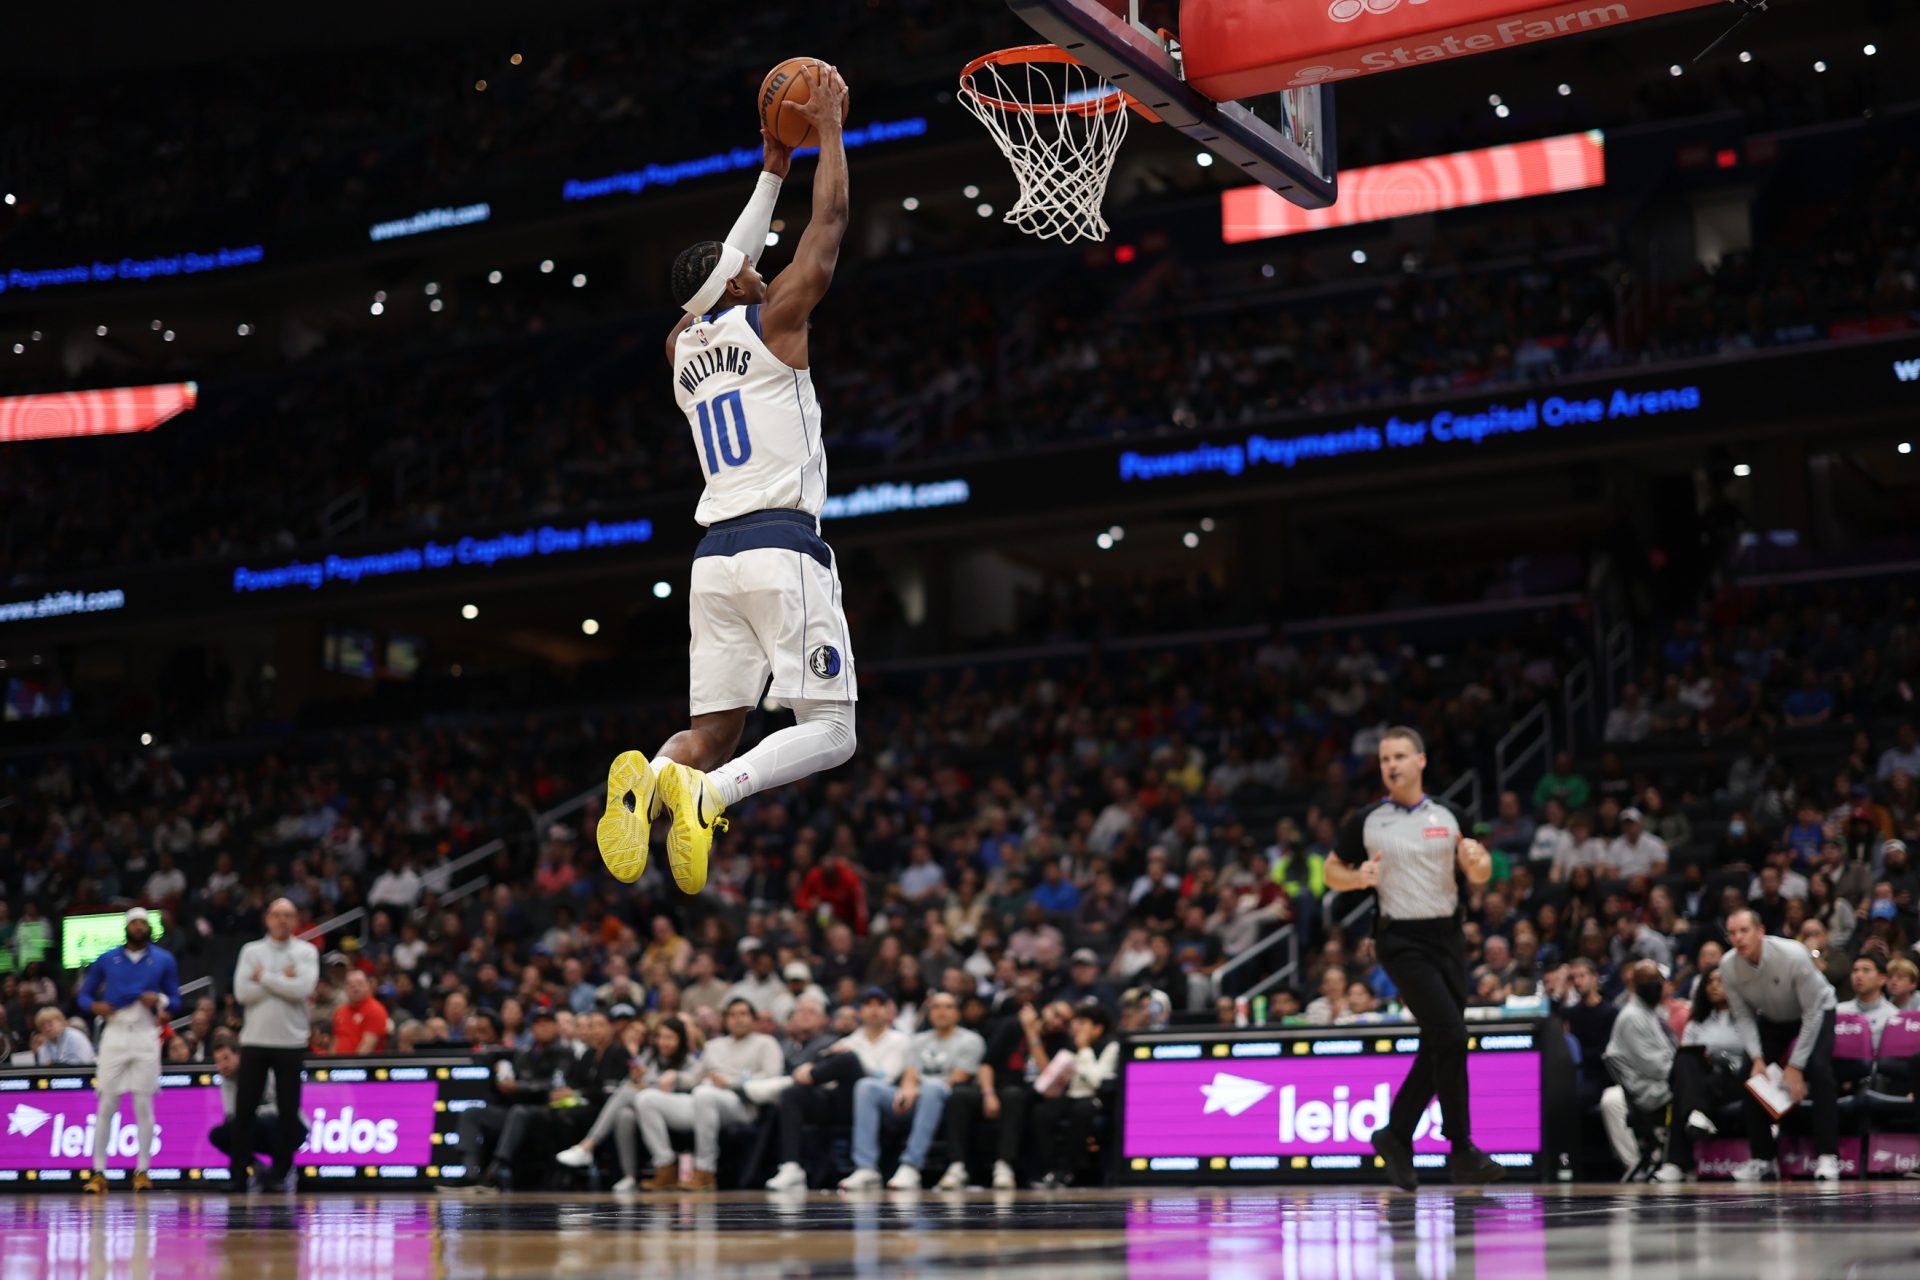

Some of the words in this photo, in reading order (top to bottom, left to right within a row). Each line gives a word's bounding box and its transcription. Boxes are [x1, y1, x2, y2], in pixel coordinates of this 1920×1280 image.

[679, 346, 752, 395] WILLIAMS
[696, 389, 752, 475] 10
[1119, 442, 1245, 481] Powering
[1246, 425, 1382, 467] Payments
[1386, 416, 1426, 447] for
[1430, 400, 1538, 443] Capital
[1541, 396, 1605, 427] One
[1608, 385, 1700, 419] Arena
[233, 561, 324, 592] Powering
[325, 548, 422, 583] Payments
[424, 541, 454, 567] for
[455, 529, 535, 566] Capital
[536, 526, 582, 554] One
[583, 519, 653, 547] Arena
[301, 1106, 399, 1155] idos
[1278, 1082, 1447, 1144] leid
